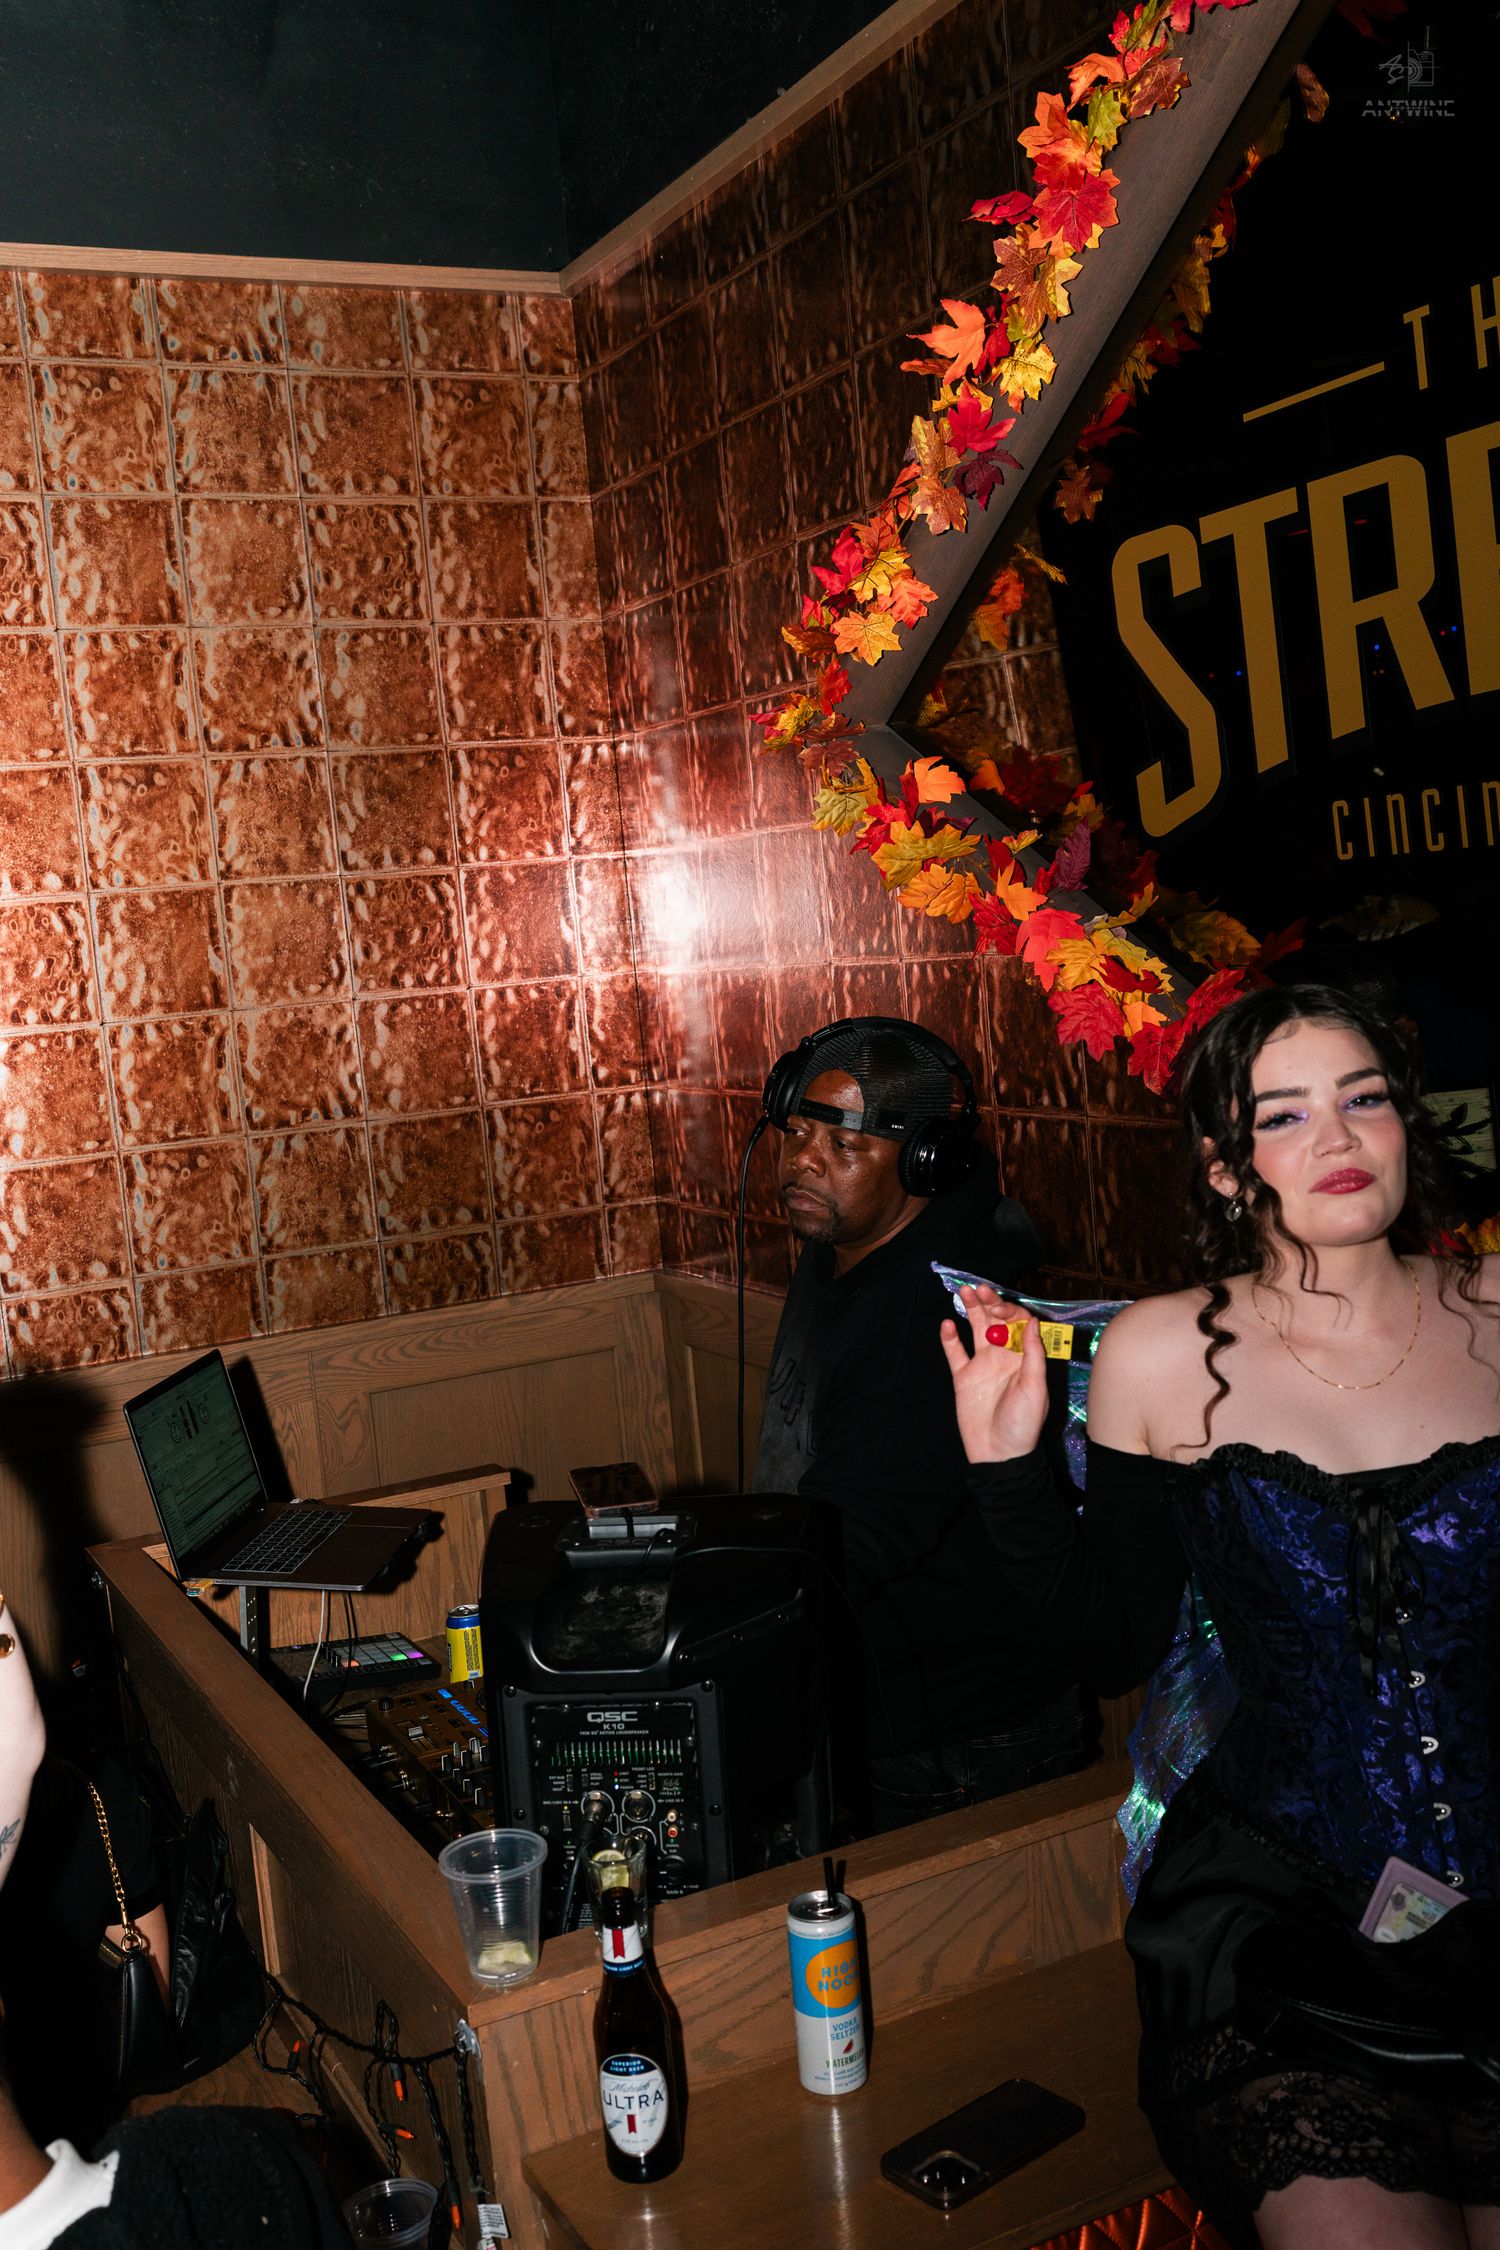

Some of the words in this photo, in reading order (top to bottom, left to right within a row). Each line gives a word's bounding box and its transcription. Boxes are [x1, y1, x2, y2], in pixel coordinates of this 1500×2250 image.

[587, 1711, 638, 1723] QSC
[832, 2016, 857, 2032] VODKA
[602, 2088, 665, 2110] ULTRA
